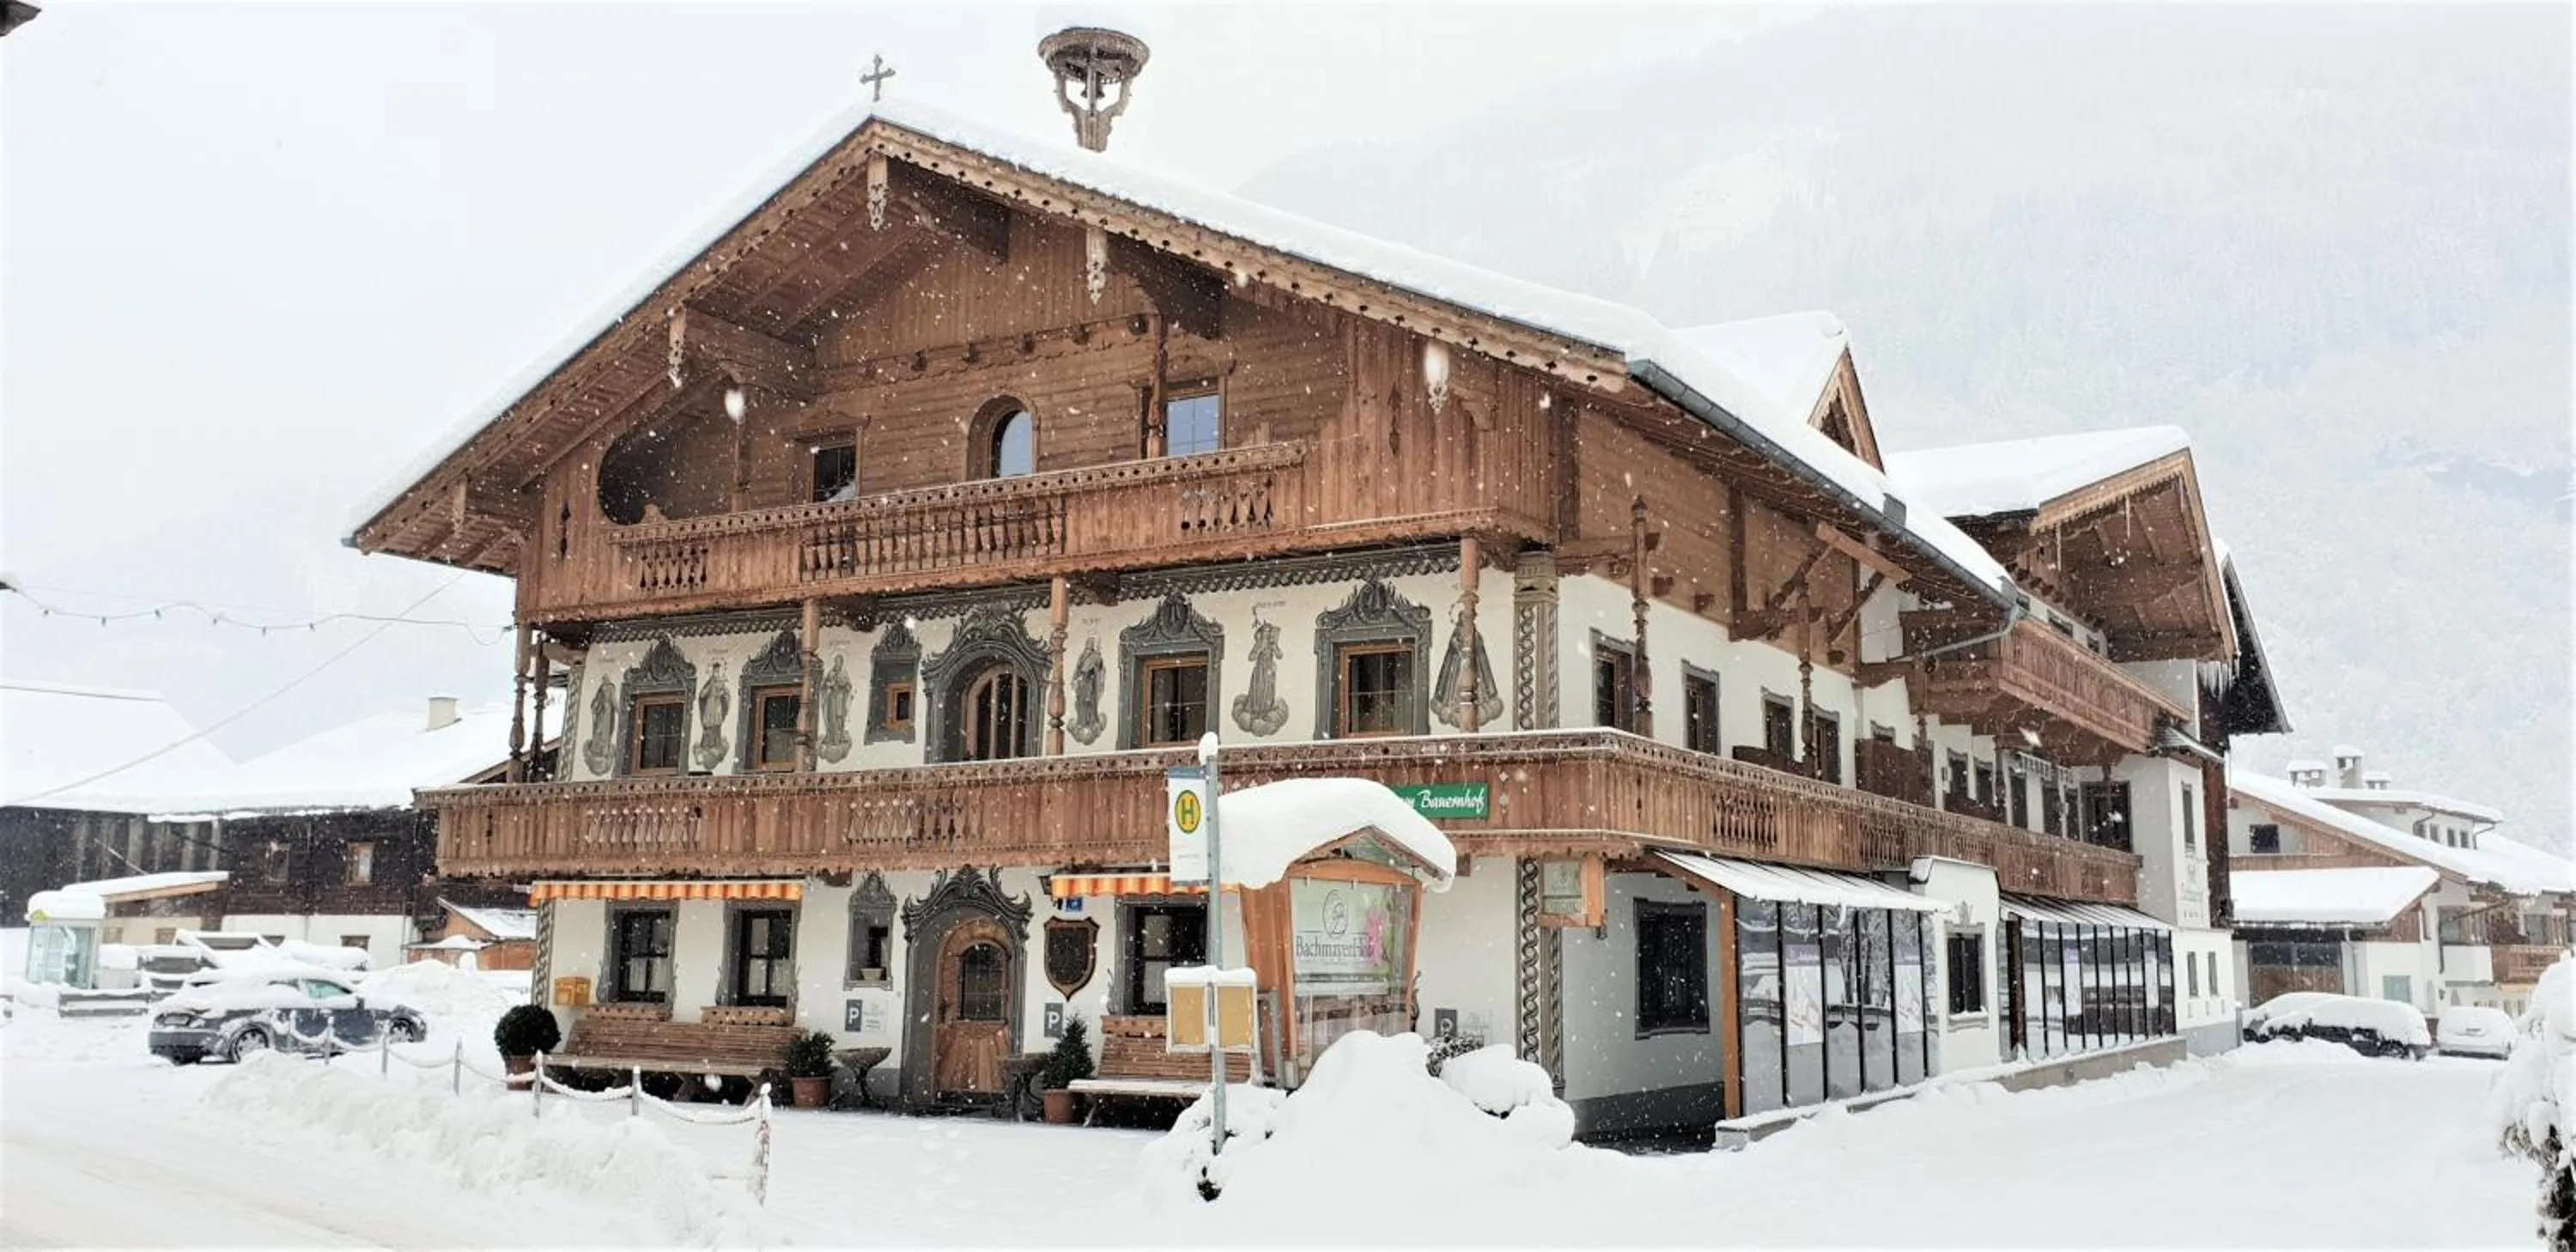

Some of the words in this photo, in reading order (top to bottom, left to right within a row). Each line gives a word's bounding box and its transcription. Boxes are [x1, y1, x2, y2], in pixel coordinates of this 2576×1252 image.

[1181, 798, 1194, 825] H
[1417, 787, 1485, 814] Bauernhof
[849, 1007, 860, 1024] P
[1048, 1011, 1060, 1029] P
